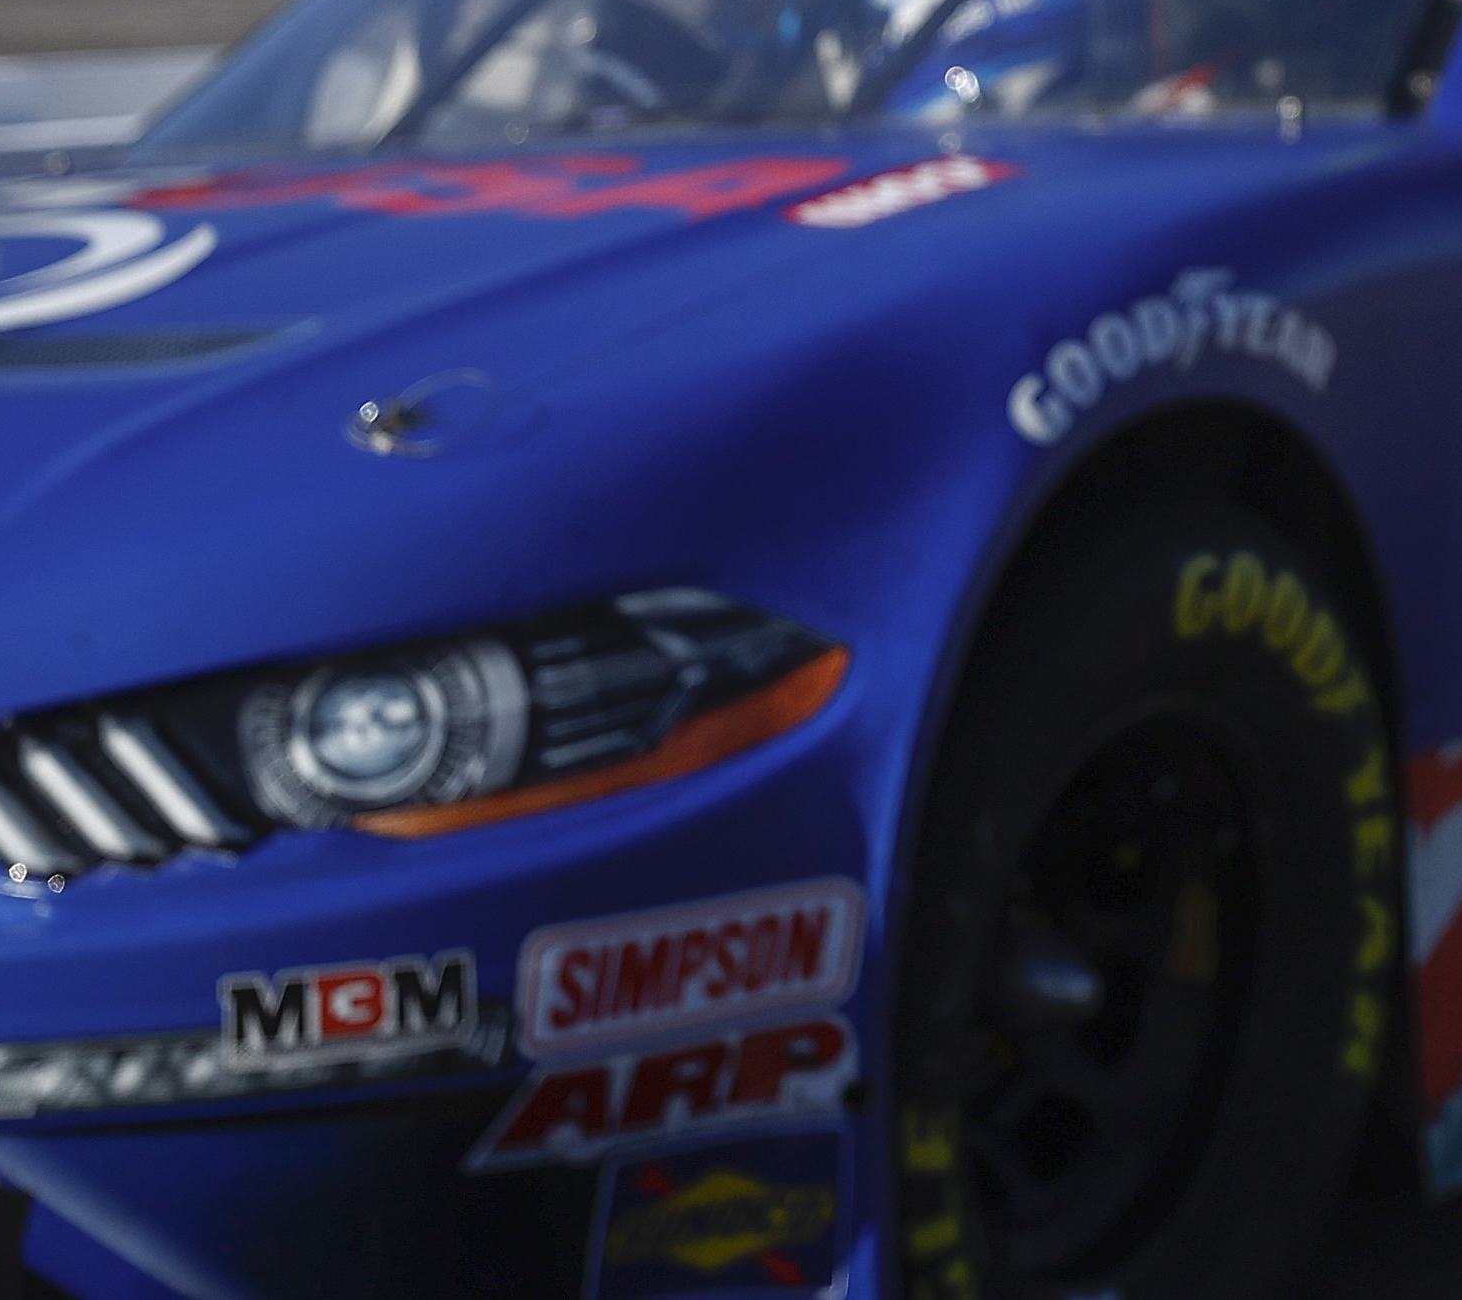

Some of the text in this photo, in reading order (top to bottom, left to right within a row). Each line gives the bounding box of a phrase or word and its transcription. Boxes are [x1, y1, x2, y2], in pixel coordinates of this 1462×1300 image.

[1007, 268, 1336, 445] GOODYEAR
[552, 906, 833, 1031] SIMPSON
[490, 1018, 850, 1158] ARP
